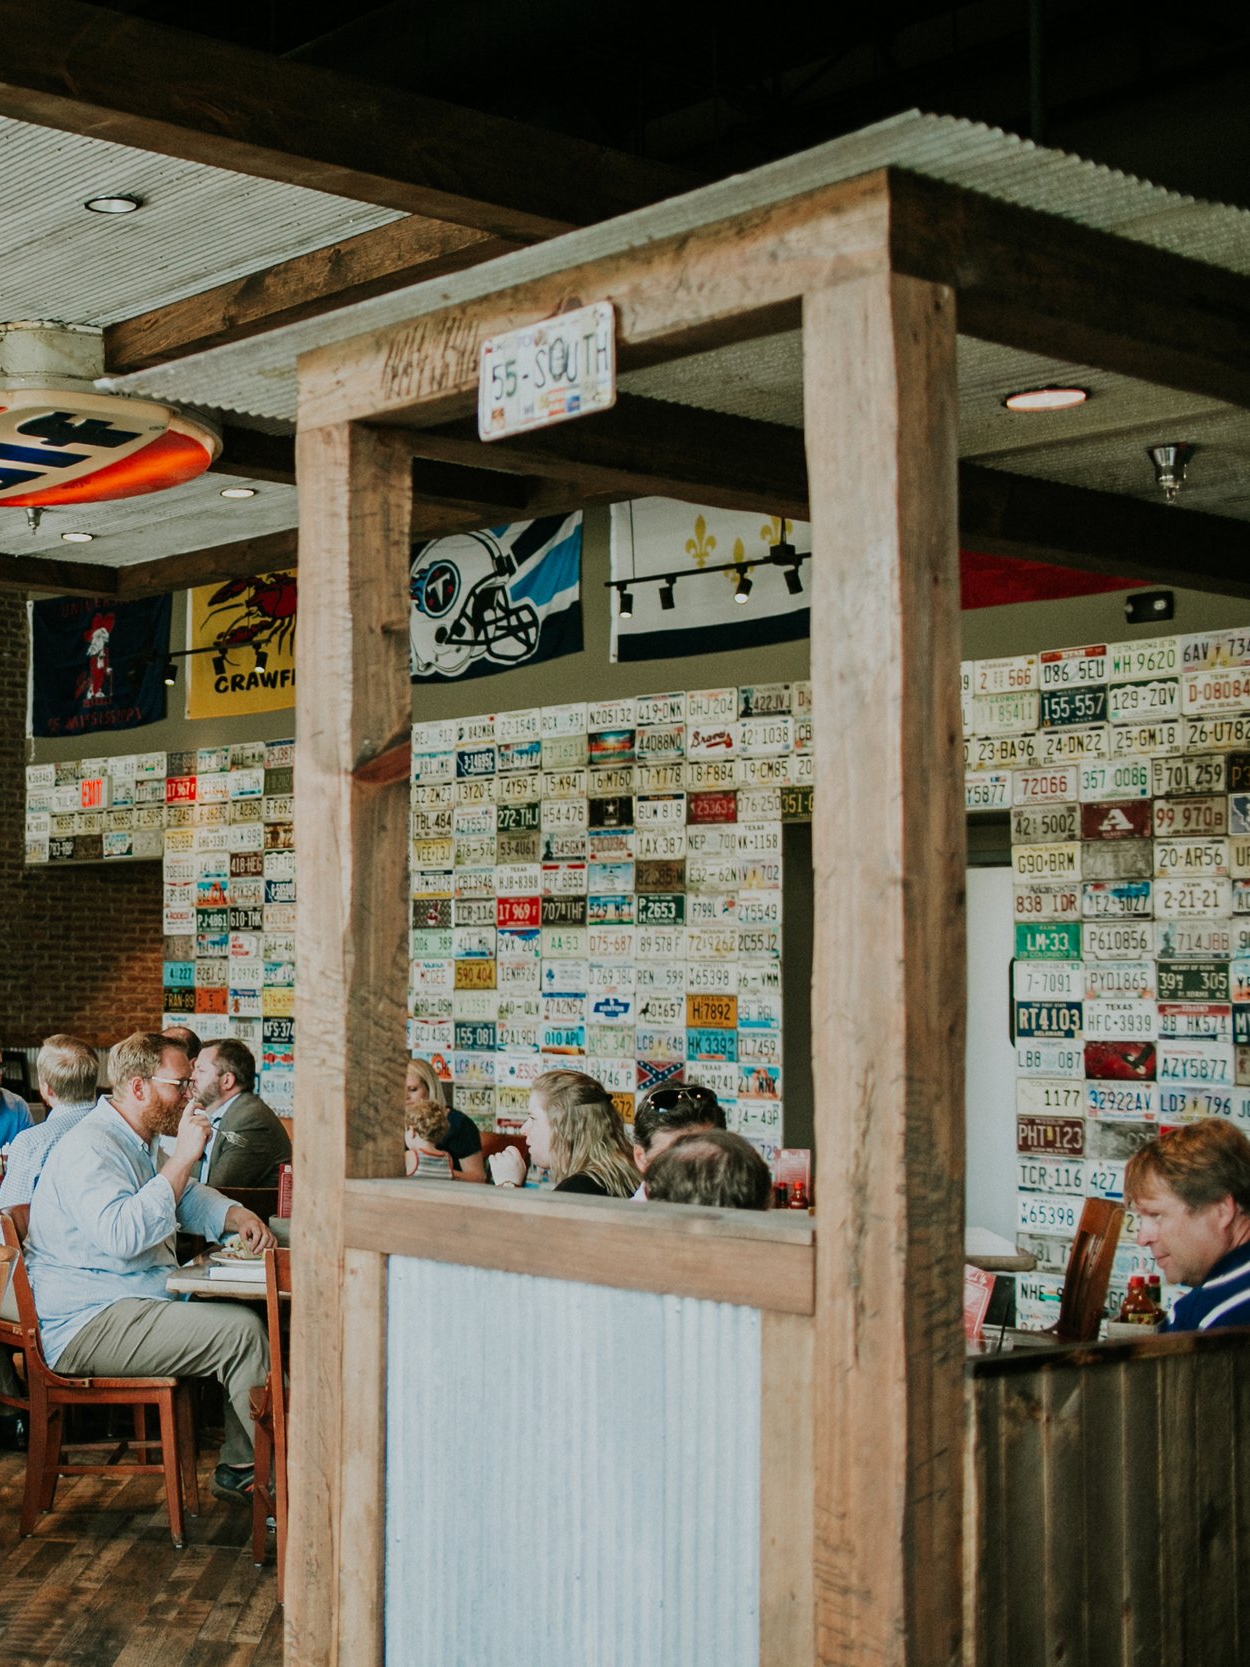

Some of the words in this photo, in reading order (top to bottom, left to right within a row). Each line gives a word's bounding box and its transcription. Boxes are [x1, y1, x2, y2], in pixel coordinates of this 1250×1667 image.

[491, 330, 610, 401] 55-SOUTH
[1137, 649, 1175, 671] 9620
[1184, 642, 1208, 662] 6AV
[1009, 668, 1031, 686] 566
[1045, 664, 1069, 683] D86
[1079, 660, 1104, 679] 5EU
[1043, 693, 1104, 720] 155-557
[763, 727, 789, 744] 1038
[1047, 734, 1101, 755] 24-DN22
[1117, 727, 1176, 749] 25-GM18
[979, 739, 1034, 761] 23-BA96
[1083, 770, 1105, 790] 357
[1115, 767, 1147, 787] 0086
[1166, 766, 1189, 786] 701
[1196, 764, 1222, 784] 259
[82, 780, 103, 808] EXIT
[1022, 776, 1067, 795] 72066
[662, 804, 682, 817] 818
[1156, 808, 1174, 828] 99
[1183, 807, 1213, 827] 970
[1015, 817, 1030, 836] 42
[1042, 814, 1075, 833] 5002
[719, 834, 736, 849] 700
[1160, 847, 1222, 868] 20-AR56
[1016, 896, 1042, 912] 838
[1053, 894, 1077, 912] IDR
[1164, 890, 1219, 909] 2-21-21
[647, 903, 675, 919] 2653
[1027, 933, 1068, 951] LM-33
[666, 970, 683, 984] 599
[1159, 972, 1176, 989] 39
[1200, 973, 1227, 990] 305
[705, 1004, 730, 1021] 7892
[1019, 1008, 1080, 1031] RT4103
[456, 1028, 494, 1045] 155-081
[688, 1038, 701, 1053] HK
[705, 1038, 734, 1055] 3392
[1059, 1051, 1081, 1069] 087
[1162, 1058, 1227, 1080] AZY5877
[1044, 1090, 1080, 1106] 1177
[1205, 1095, 1231, 1114] 796
[1018, 1125, 1047, 1146] PHT
[1055, 1126, 1082, 1148] 123
[1090, 1172, 1117, 1191] 427
[1030, 1206, 1074, 1226] 65398
